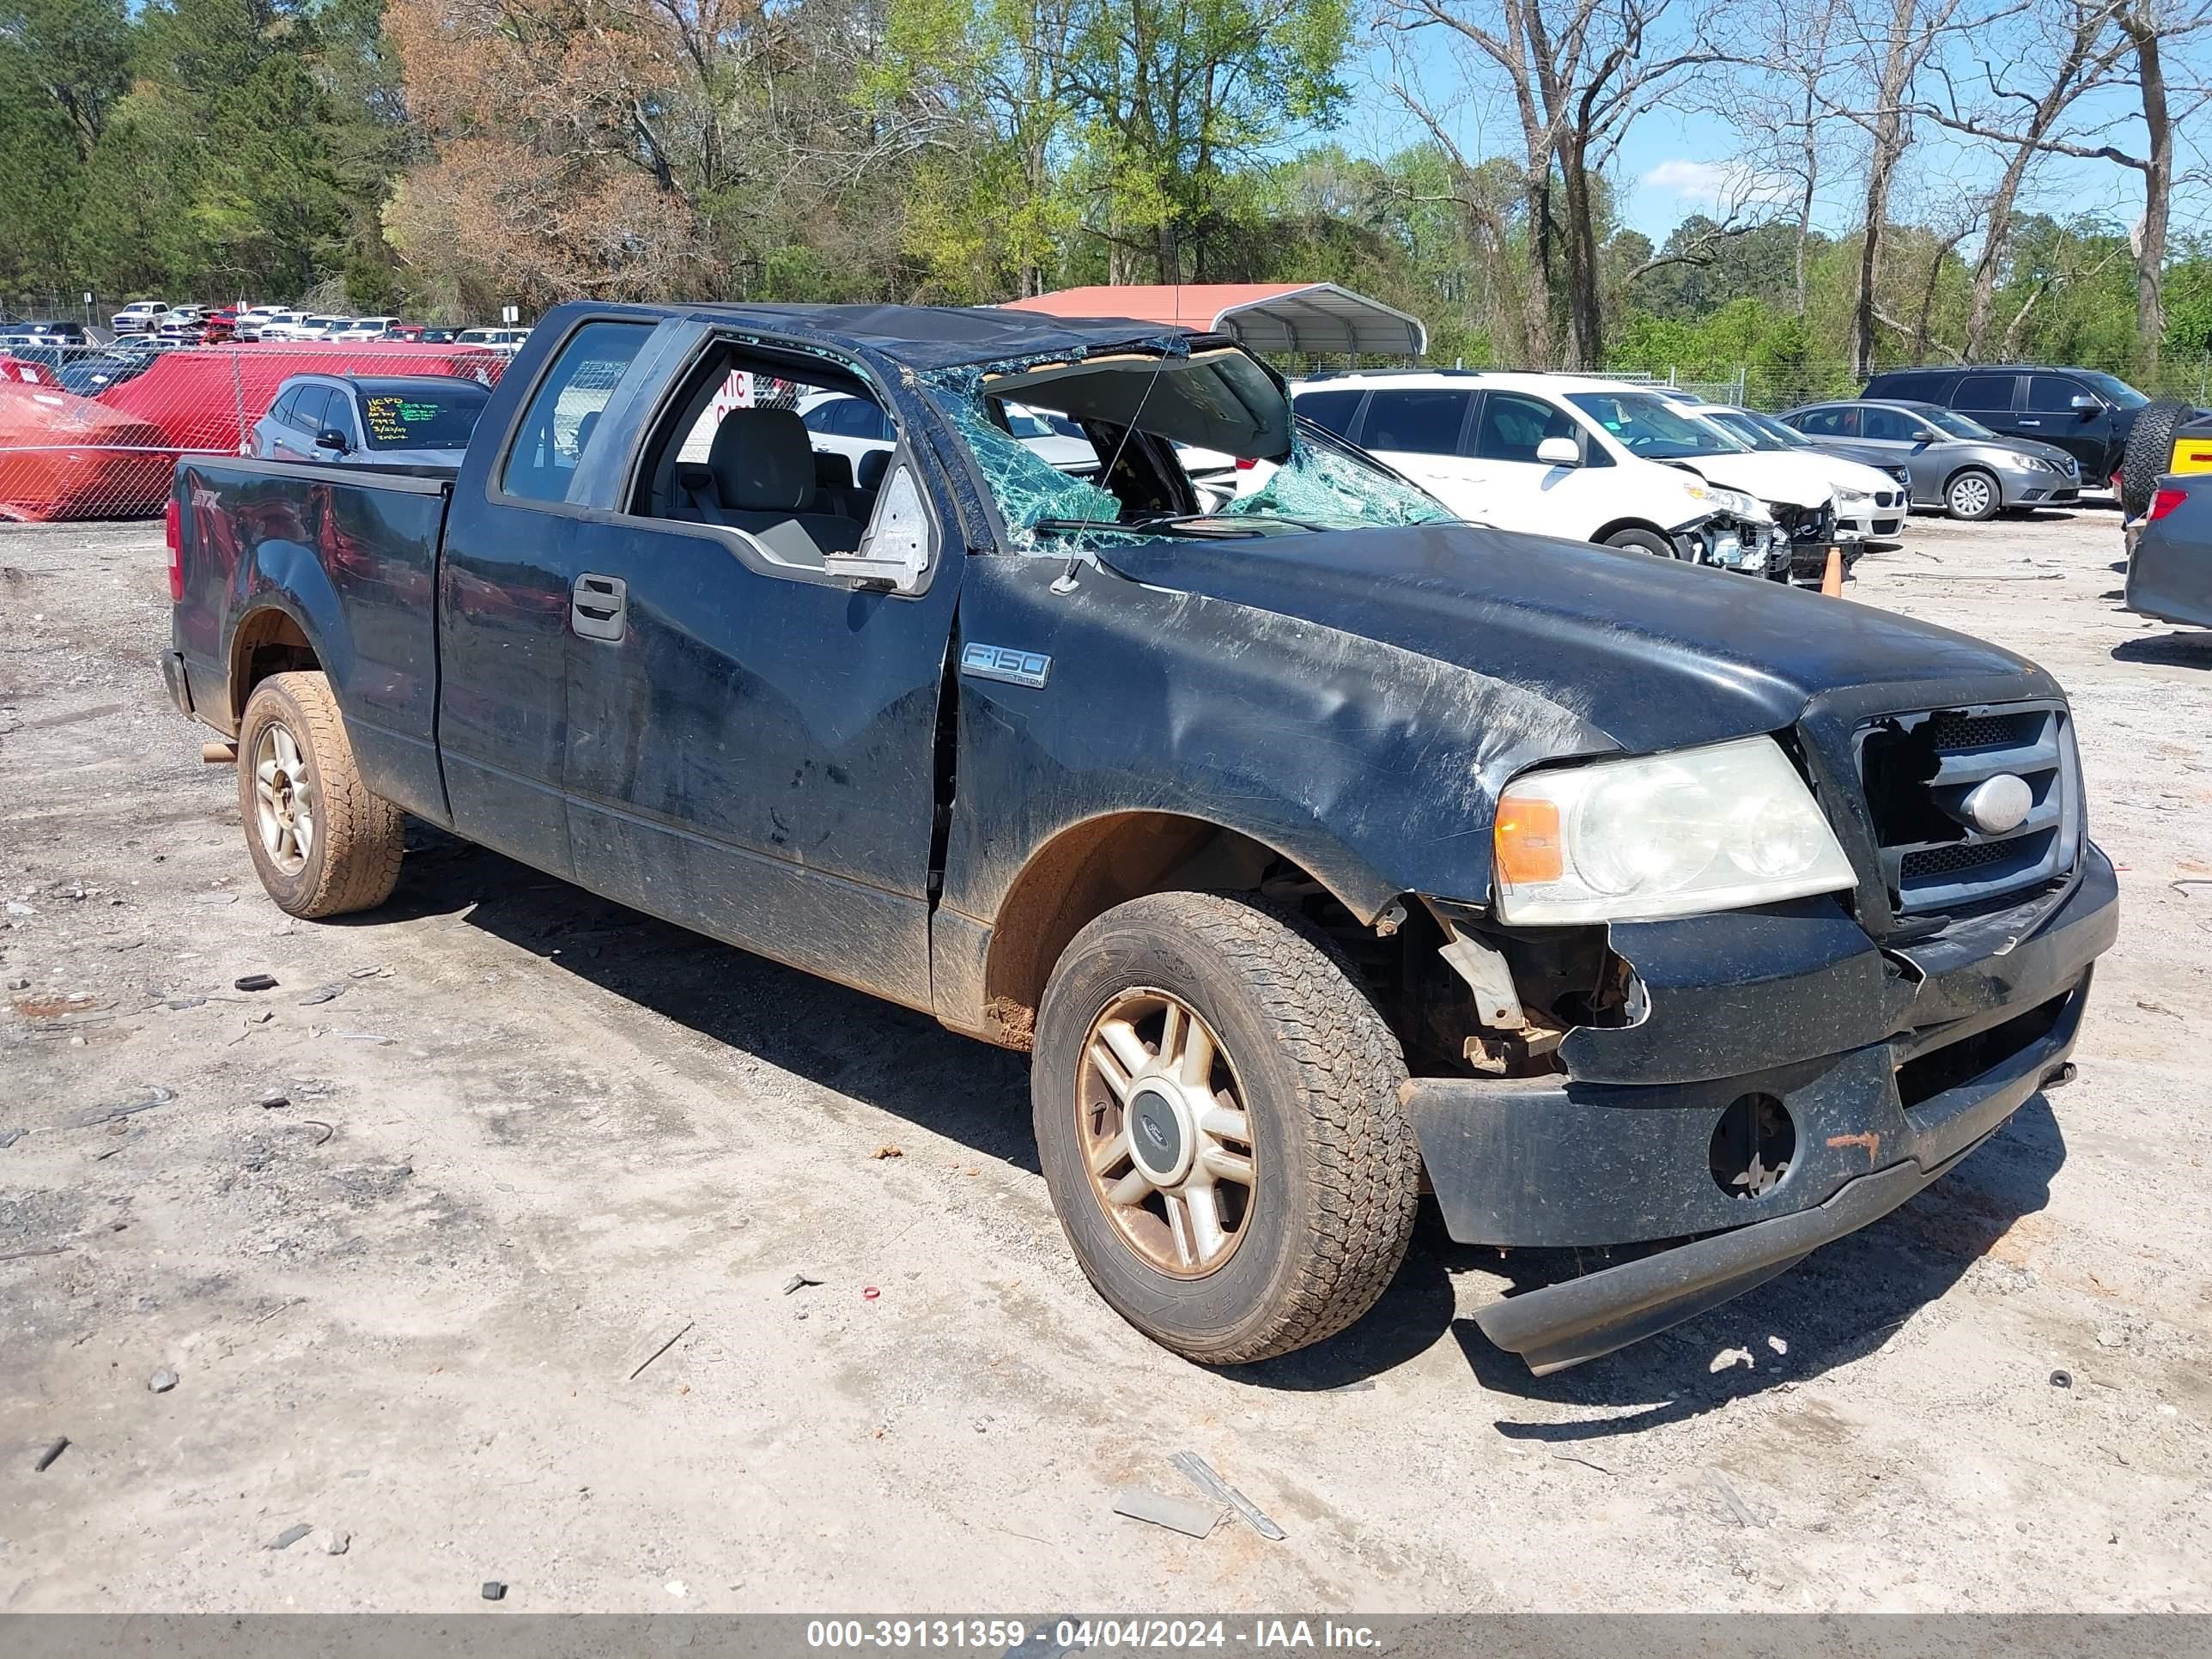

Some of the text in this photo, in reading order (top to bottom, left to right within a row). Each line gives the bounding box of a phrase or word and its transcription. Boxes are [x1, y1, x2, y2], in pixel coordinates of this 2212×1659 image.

[191, 489, 222, 508] STX
[964, 645, 1047, 675] F-150
[1012, 674, 1042, 686] TRITON
[1148, 1123, 1164, 1142] Ford
